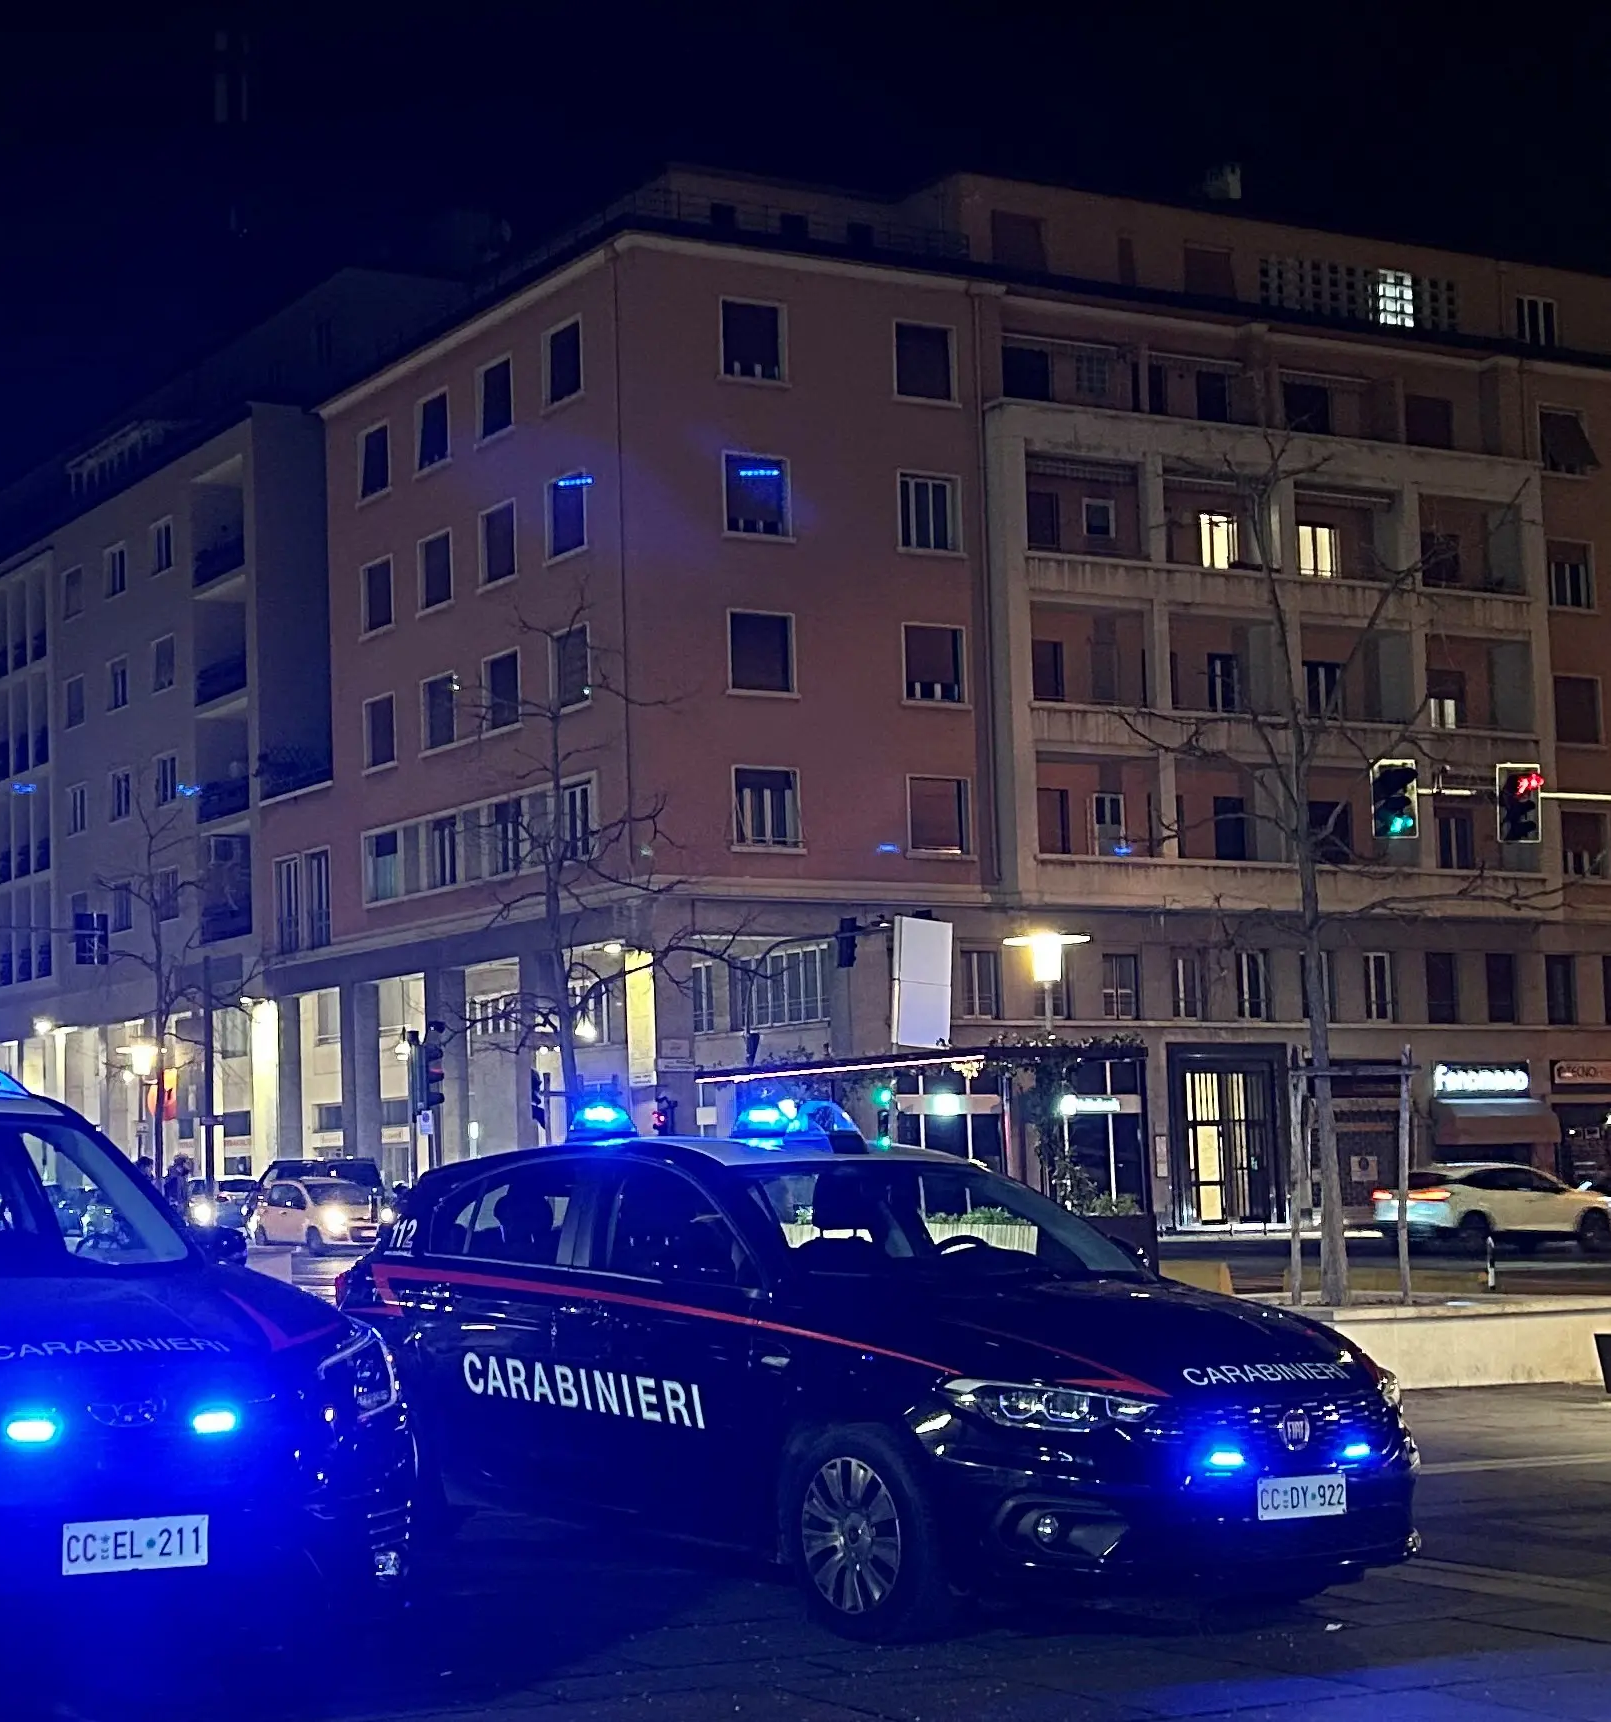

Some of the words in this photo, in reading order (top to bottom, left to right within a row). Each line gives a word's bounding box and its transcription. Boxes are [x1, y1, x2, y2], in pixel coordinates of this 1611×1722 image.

[388, 1218, 418, 1248] 112
[1182, 1362, 1351, 1386] CARABINIERI
[462, 1351, 706, 1430] CARABINIERI
